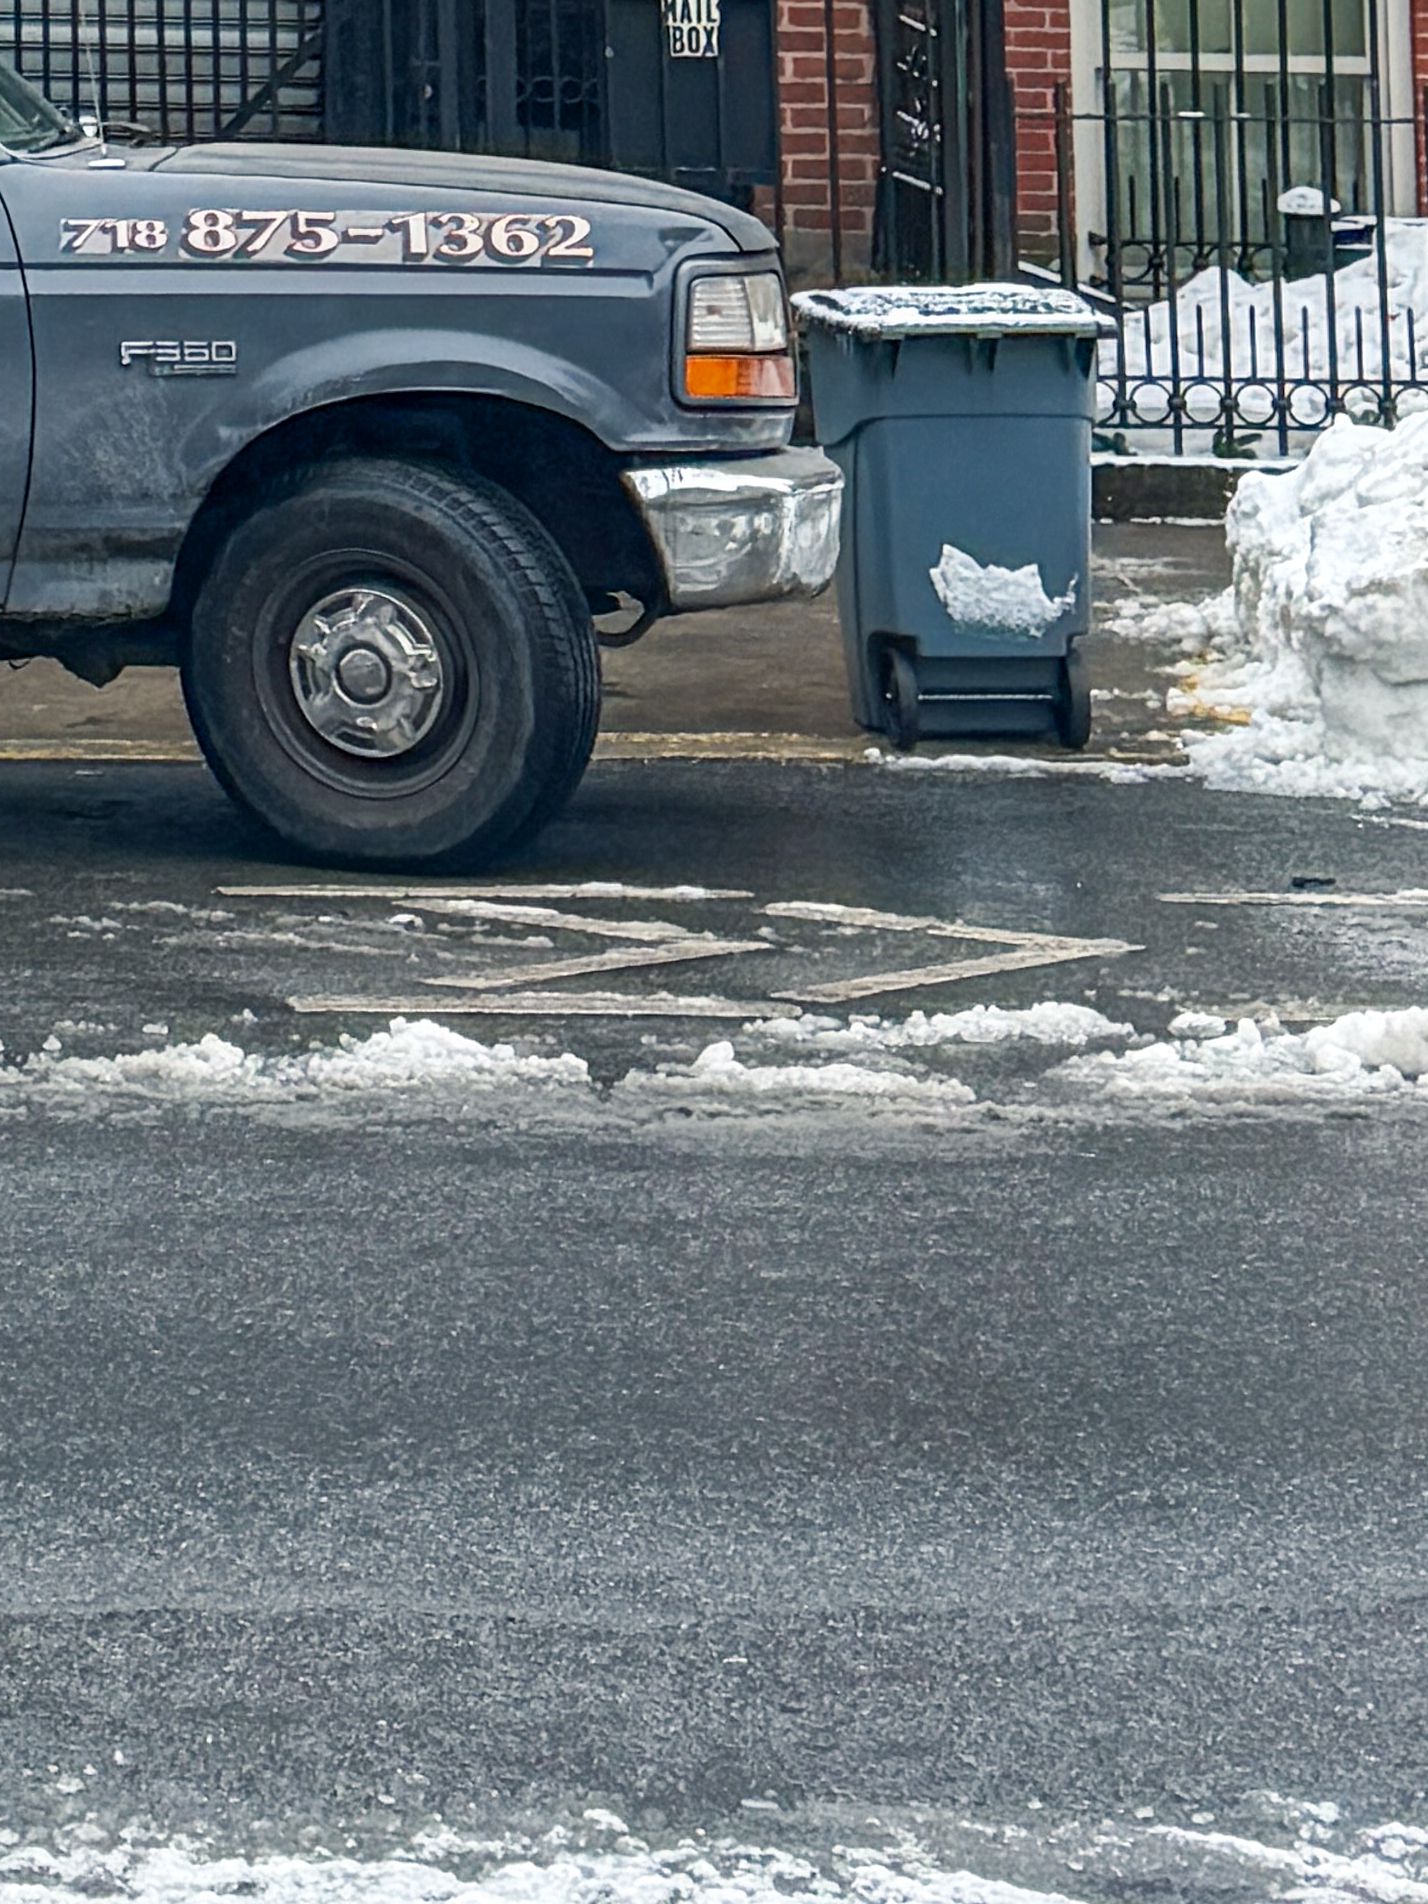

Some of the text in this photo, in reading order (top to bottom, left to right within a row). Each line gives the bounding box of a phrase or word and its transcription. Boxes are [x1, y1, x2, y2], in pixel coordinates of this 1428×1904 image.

[672, 26, 715, 54] BOX
[63, 209, 594, 259] 718 875-1362
